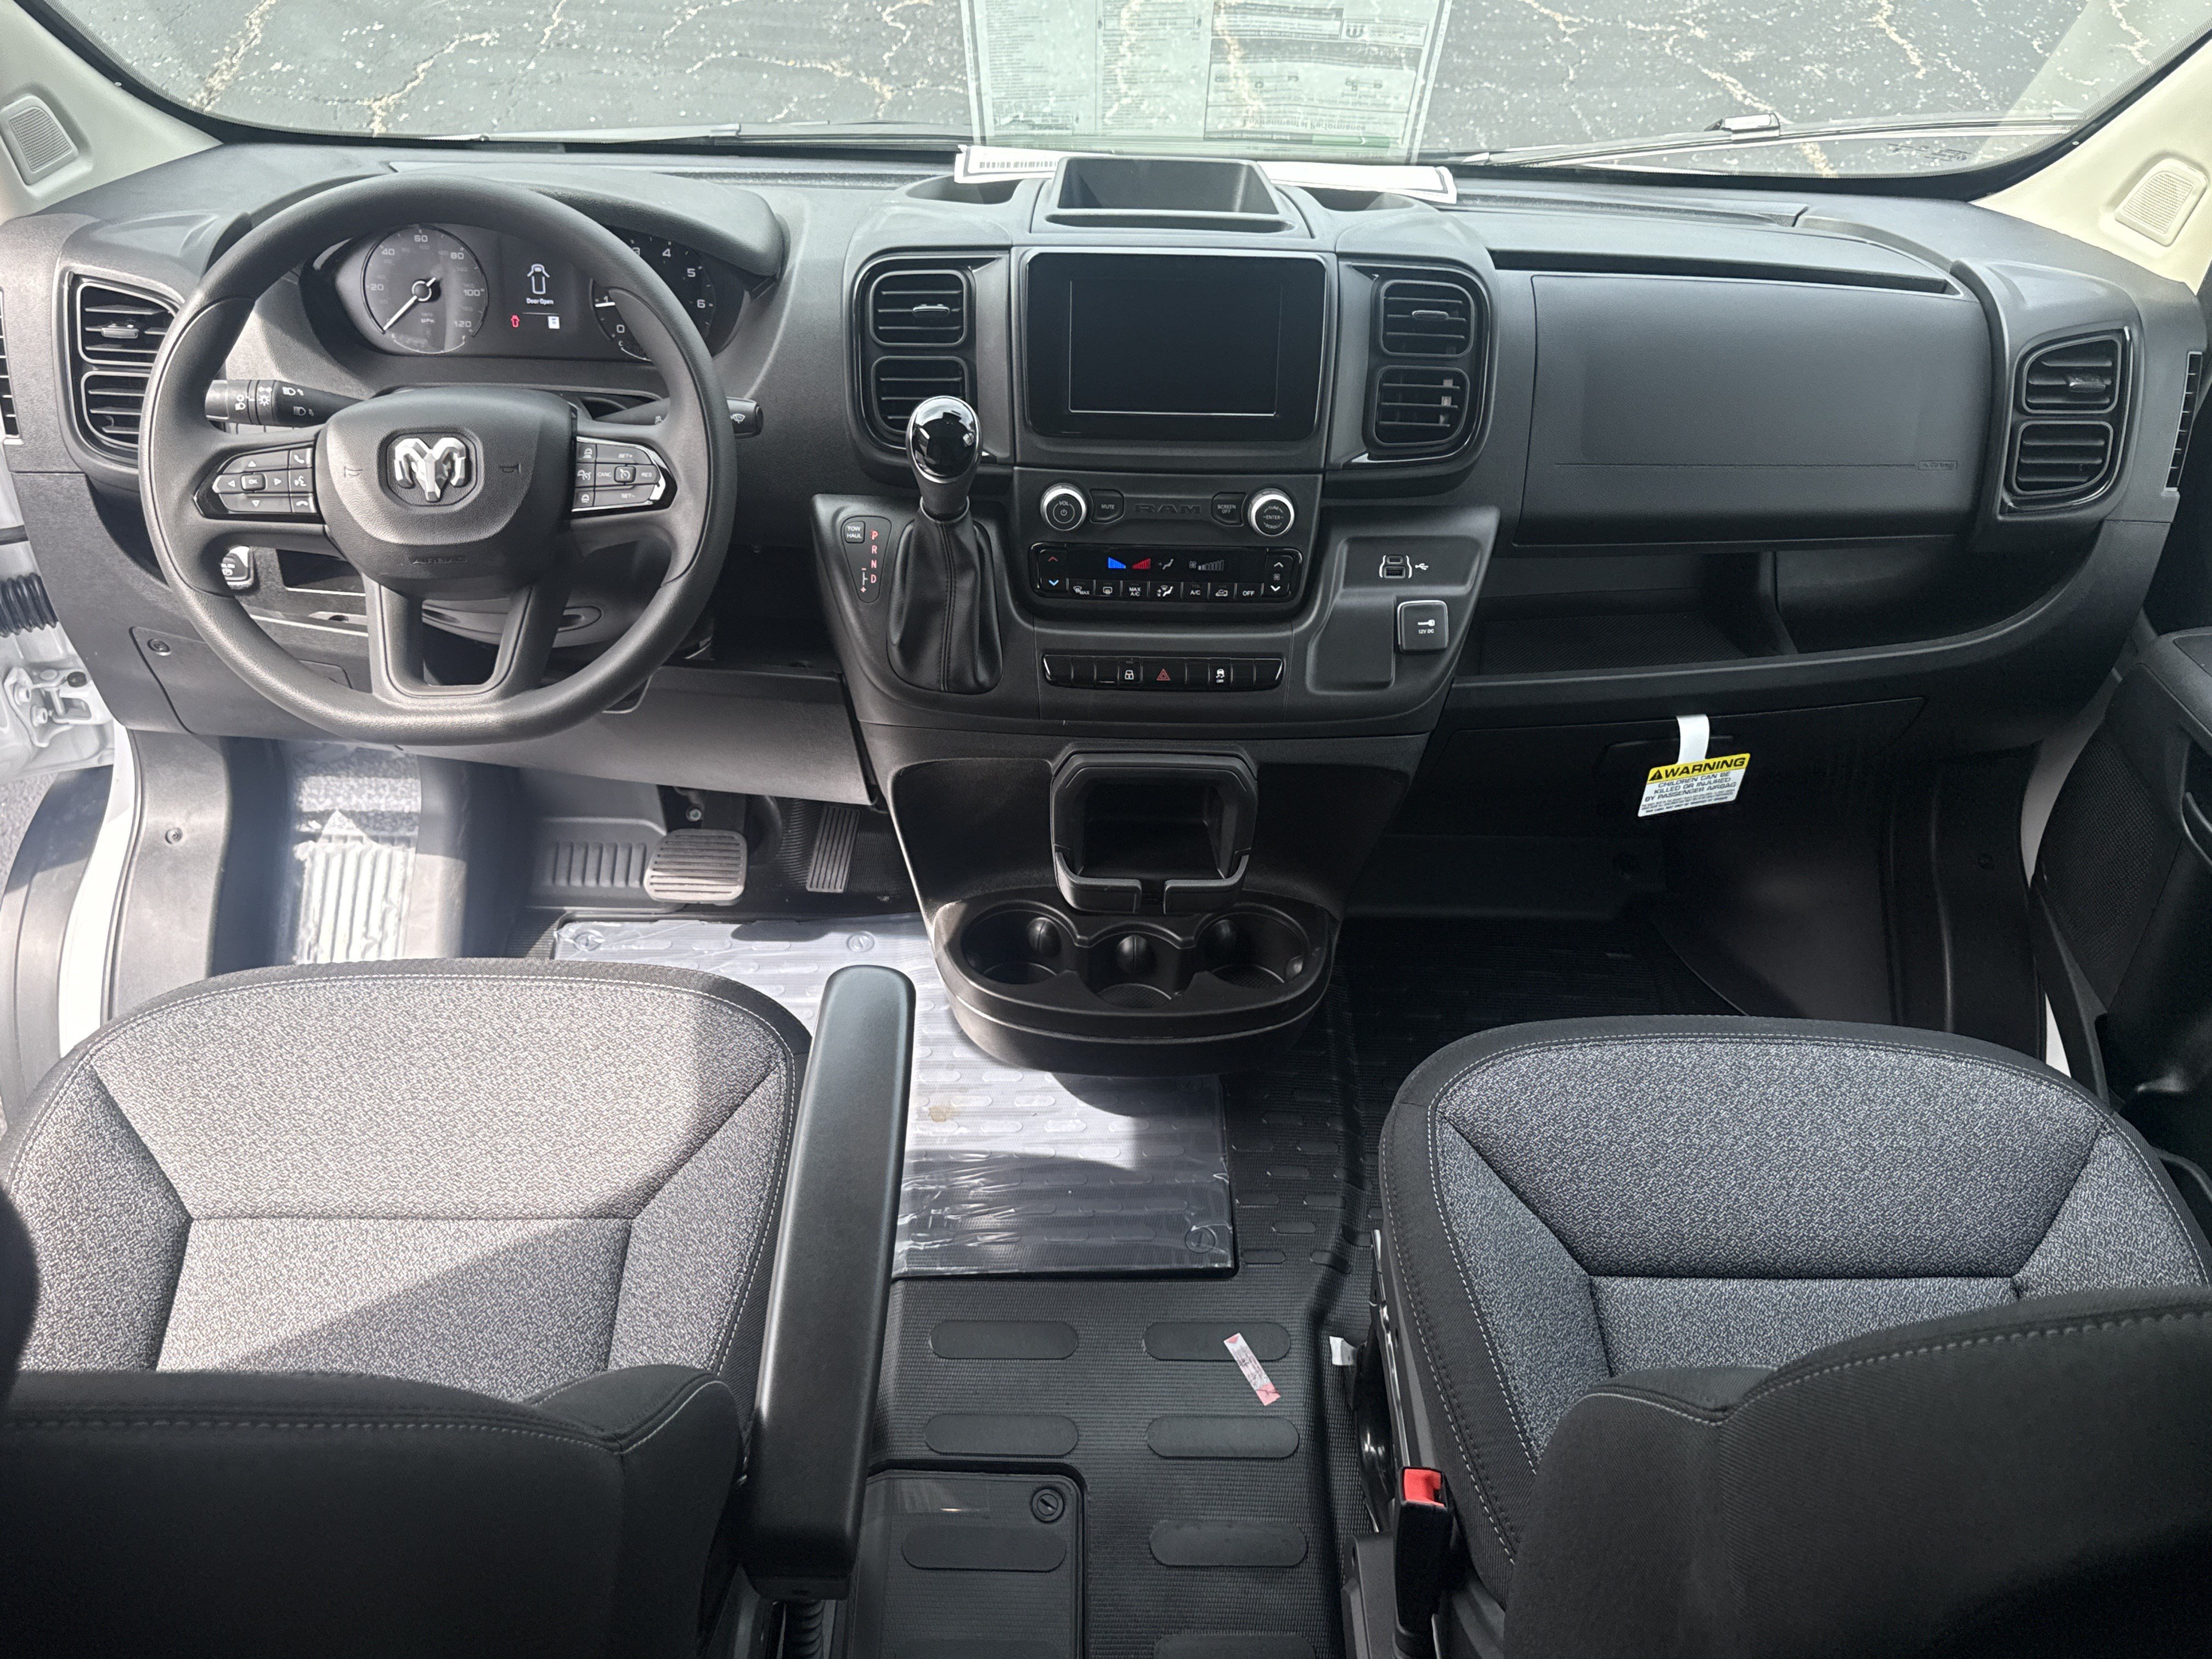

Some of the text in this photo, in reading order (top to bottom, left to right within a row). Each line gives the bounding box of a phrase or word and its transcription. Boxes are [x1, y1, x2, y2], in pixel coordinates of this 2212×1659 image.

[450, 252, 465, 260] 80
[662, 248, 672, 257] 4
[687, 268, 696, 278] 5
[697, 299, 706, 308] 6
[616, 324, 625, 334] 0
[1134, 504, 1201, 514] RAM
[871, 531, 879, 540] P
[871, 545, 878, 554] R
[871, 560, 877, 569] N
[870, 574, 877, 583] D
[1664, 757, 1746, 778] WARNING
[1654, 785, 1681, 794] KILLED
[1696, 777, 1731, 787] INJURED
[1658, 777, 1698, 788] CHILDREN
[1657, 787, 1704, 799] PASSENGER
[1707, 782, 1736, 791] AIRBAG
